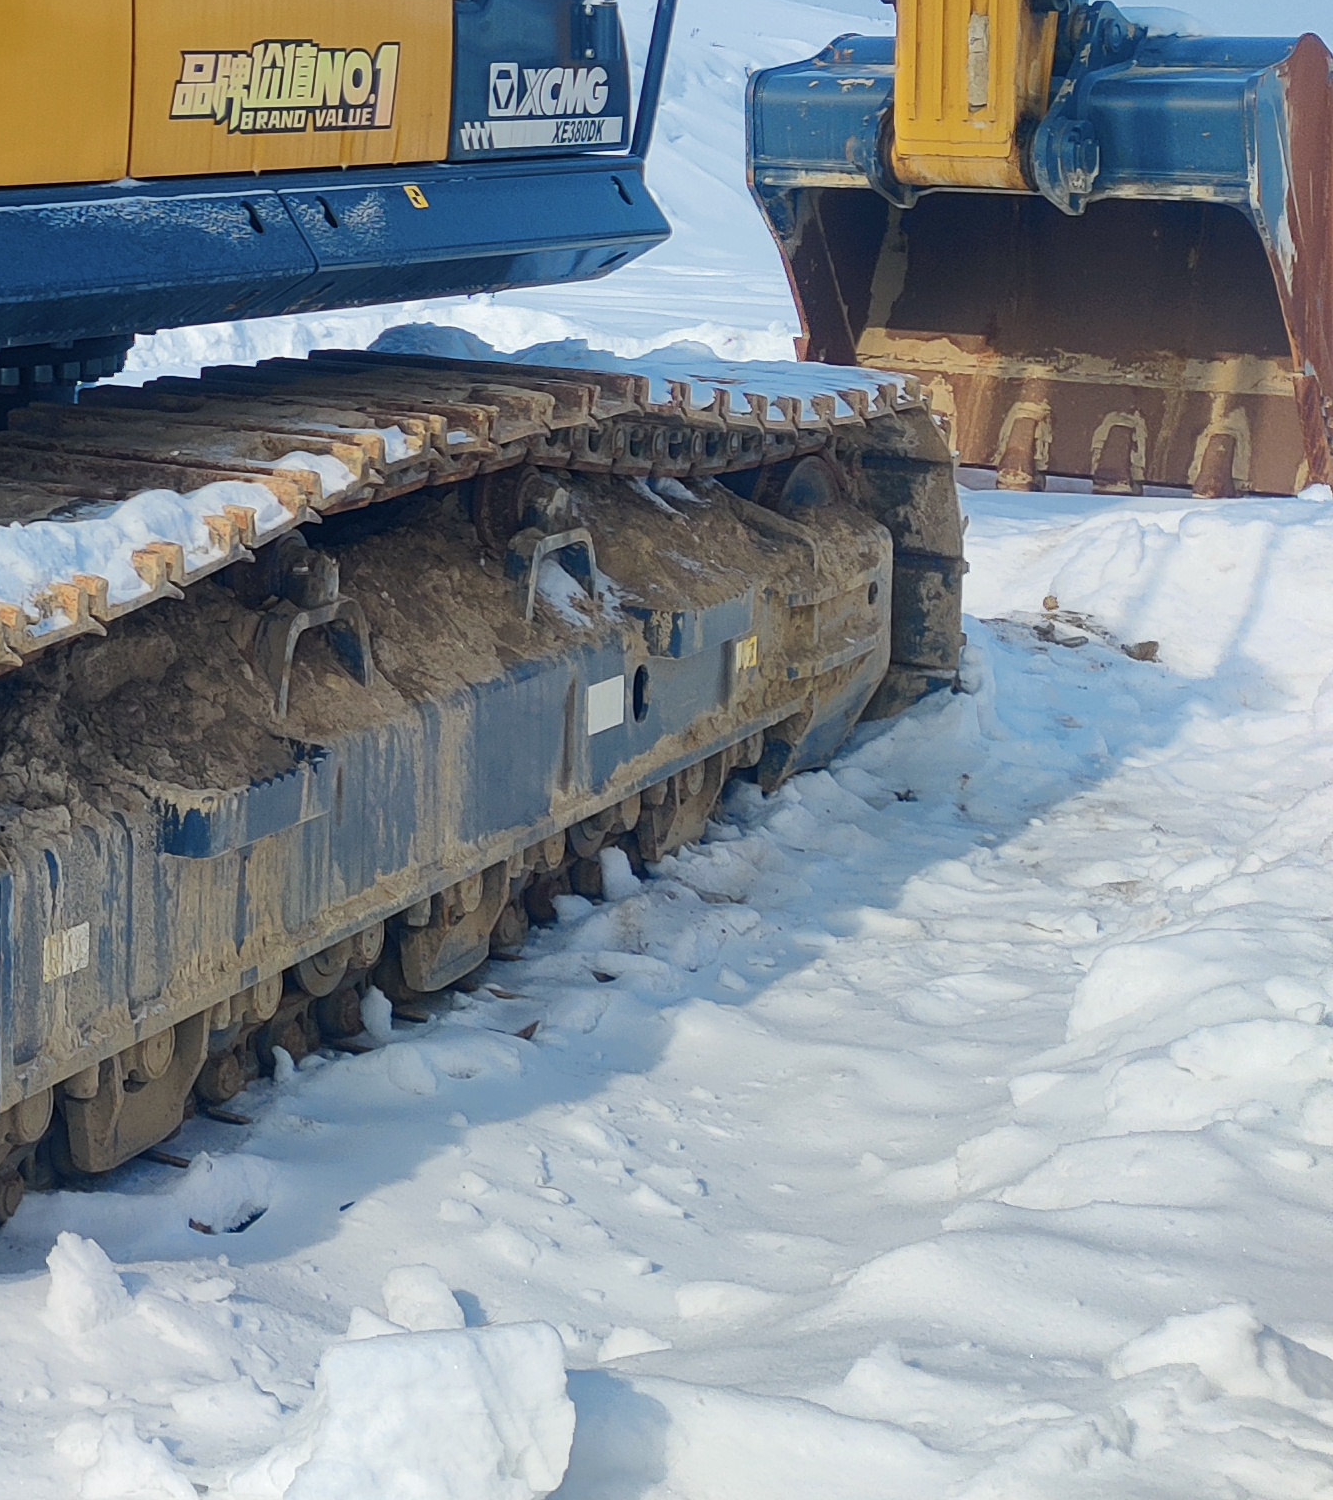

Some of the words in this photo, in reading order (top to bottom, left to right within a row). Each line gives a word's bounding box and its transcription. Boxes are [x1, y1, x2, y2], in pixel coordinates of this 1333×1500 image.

[515, 66, 609, 116] XCMG
[239, 109, 307, 130] BRAND
[314, 107, 373, 127] VALUE
[551, 119, 605, 144] XE380DK
